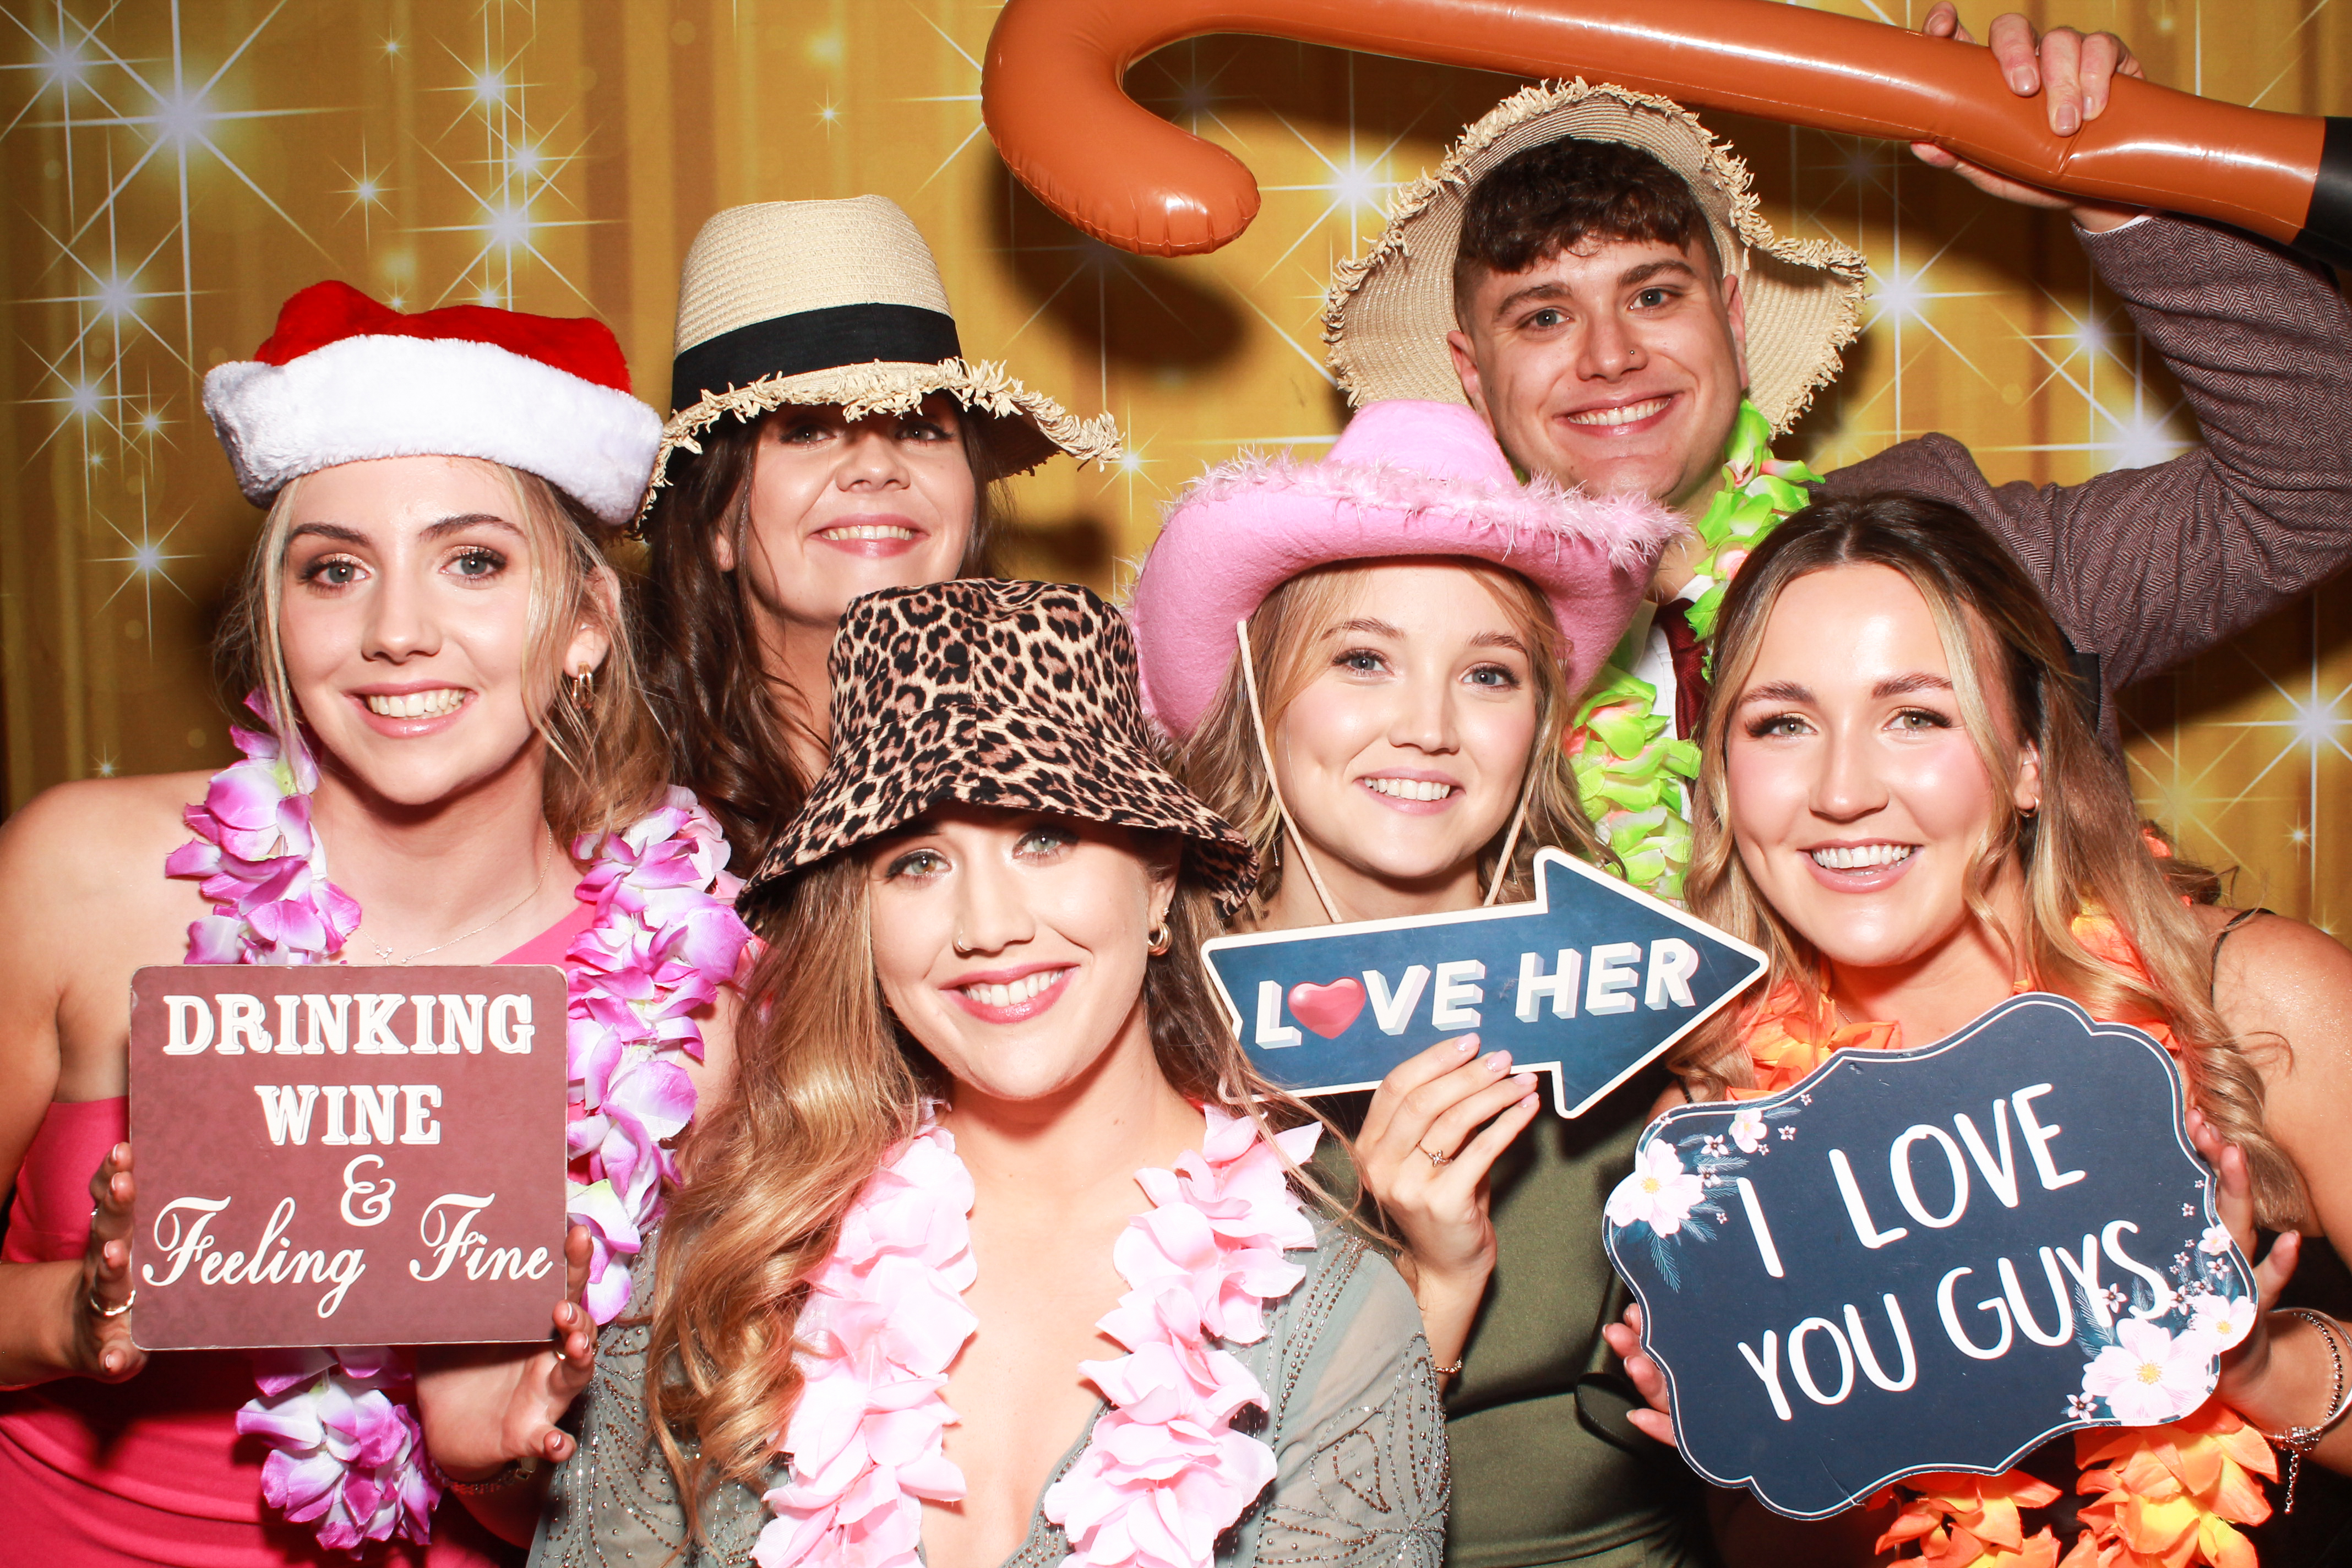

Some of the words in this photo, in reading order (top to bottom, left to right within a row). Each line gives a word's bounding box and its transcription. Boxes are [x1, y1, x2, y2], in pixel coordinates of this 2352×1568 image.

[1515, 938, 1699, 1022] HER
[162, 994, 535, 1055] DRINKING
[254, 1085, 442, 1145] WINE
[340, 1153, 396, 1227] &
[1736, 1177, 1784, 1277] I
[1828, 1083, 2086, 1249] LOVE
[141, 1195, 366, 1318] Feeling
[409, 1193, 553, 1282] Fine
[1738, 1293, 1916, 1420] YOU
[1936, 1220, 2171, 1359] GUYS
